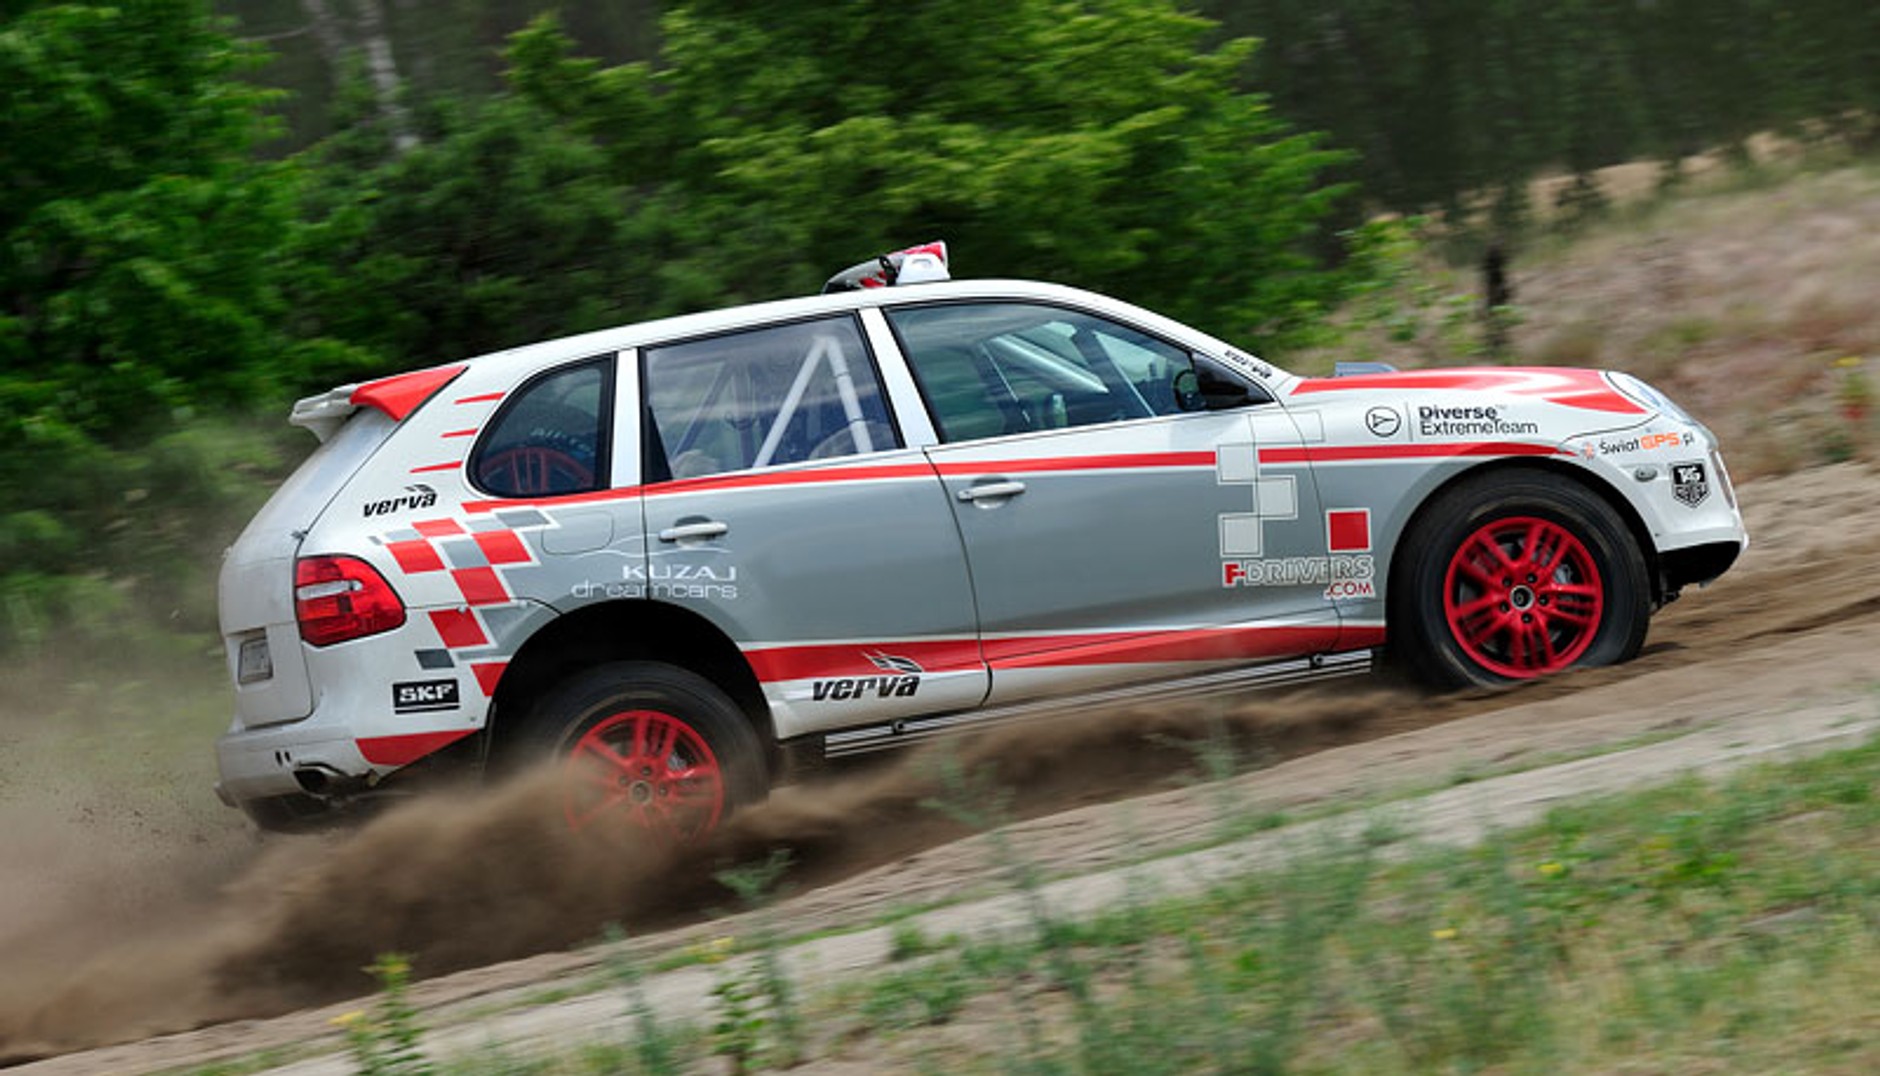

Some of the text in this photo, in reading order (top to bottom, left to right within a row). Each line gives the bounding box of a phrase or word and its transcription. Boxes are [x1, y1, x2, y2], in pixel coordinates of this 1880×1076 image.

[1418, 405, 1500, 420] Diverse
[1420, 419, 1539, 436] ExtremeTeam
[363, 492, 437, 518] verva
[622, 563, 737, 582] KUZAJ
[1222, 555, 1375, 588] F-DRIVERS
[570, 578, 738, 599] dreamcars
[1324, 581, 1374, 598] .COM
[399, 683, 454, 702] SKF
[813, 674, 921, 701] verva
